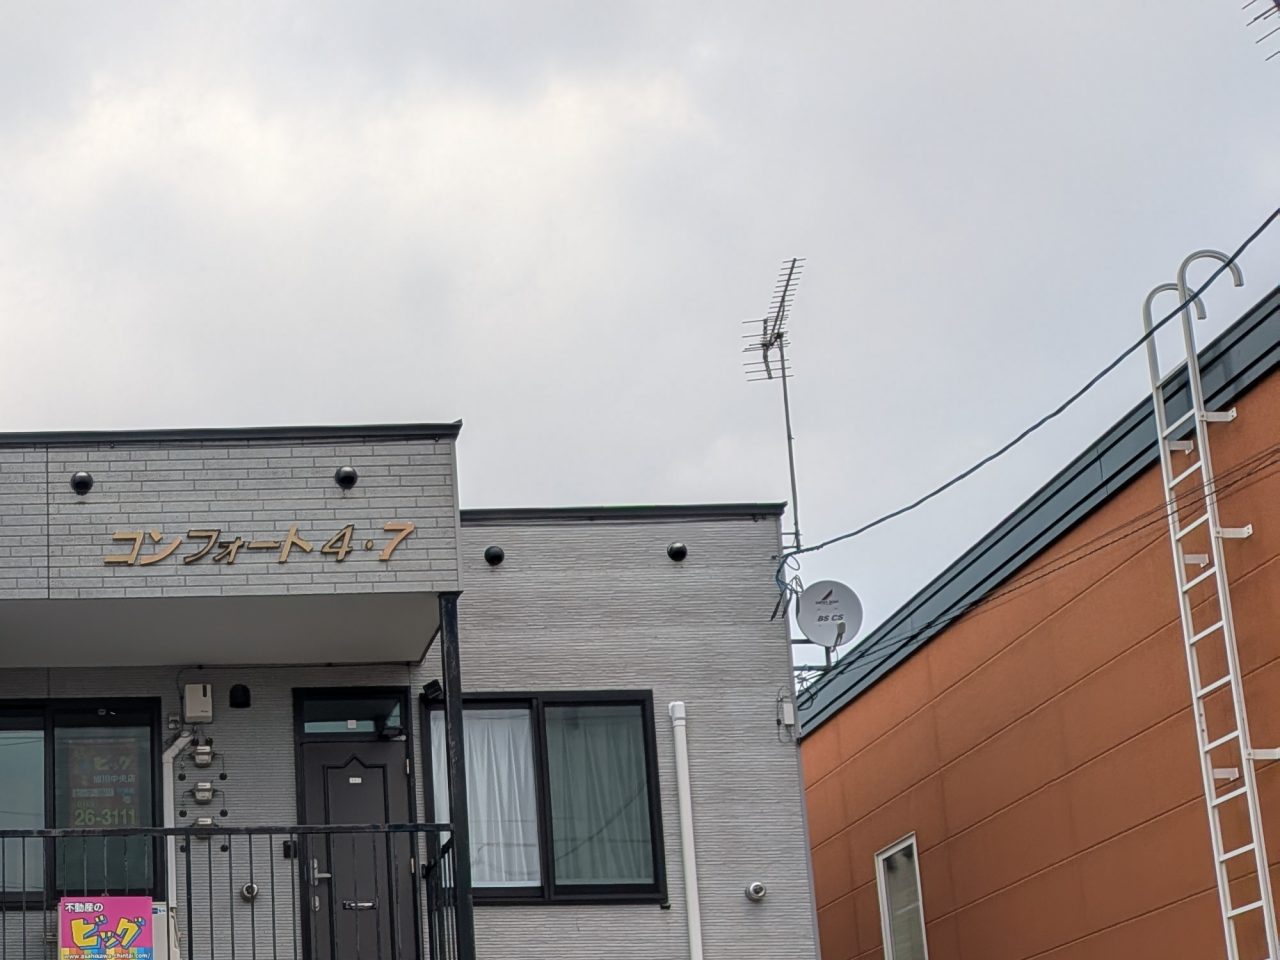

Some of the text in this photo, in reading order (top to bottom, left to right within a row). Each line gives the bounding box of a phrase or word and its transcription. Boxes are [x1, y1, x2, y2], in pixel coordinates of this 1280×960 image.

[74, 808, 136, 826] 26-3111
[64, 902, 104, 913] 不動産の
[70, 914, 146, 950] ビッグ
